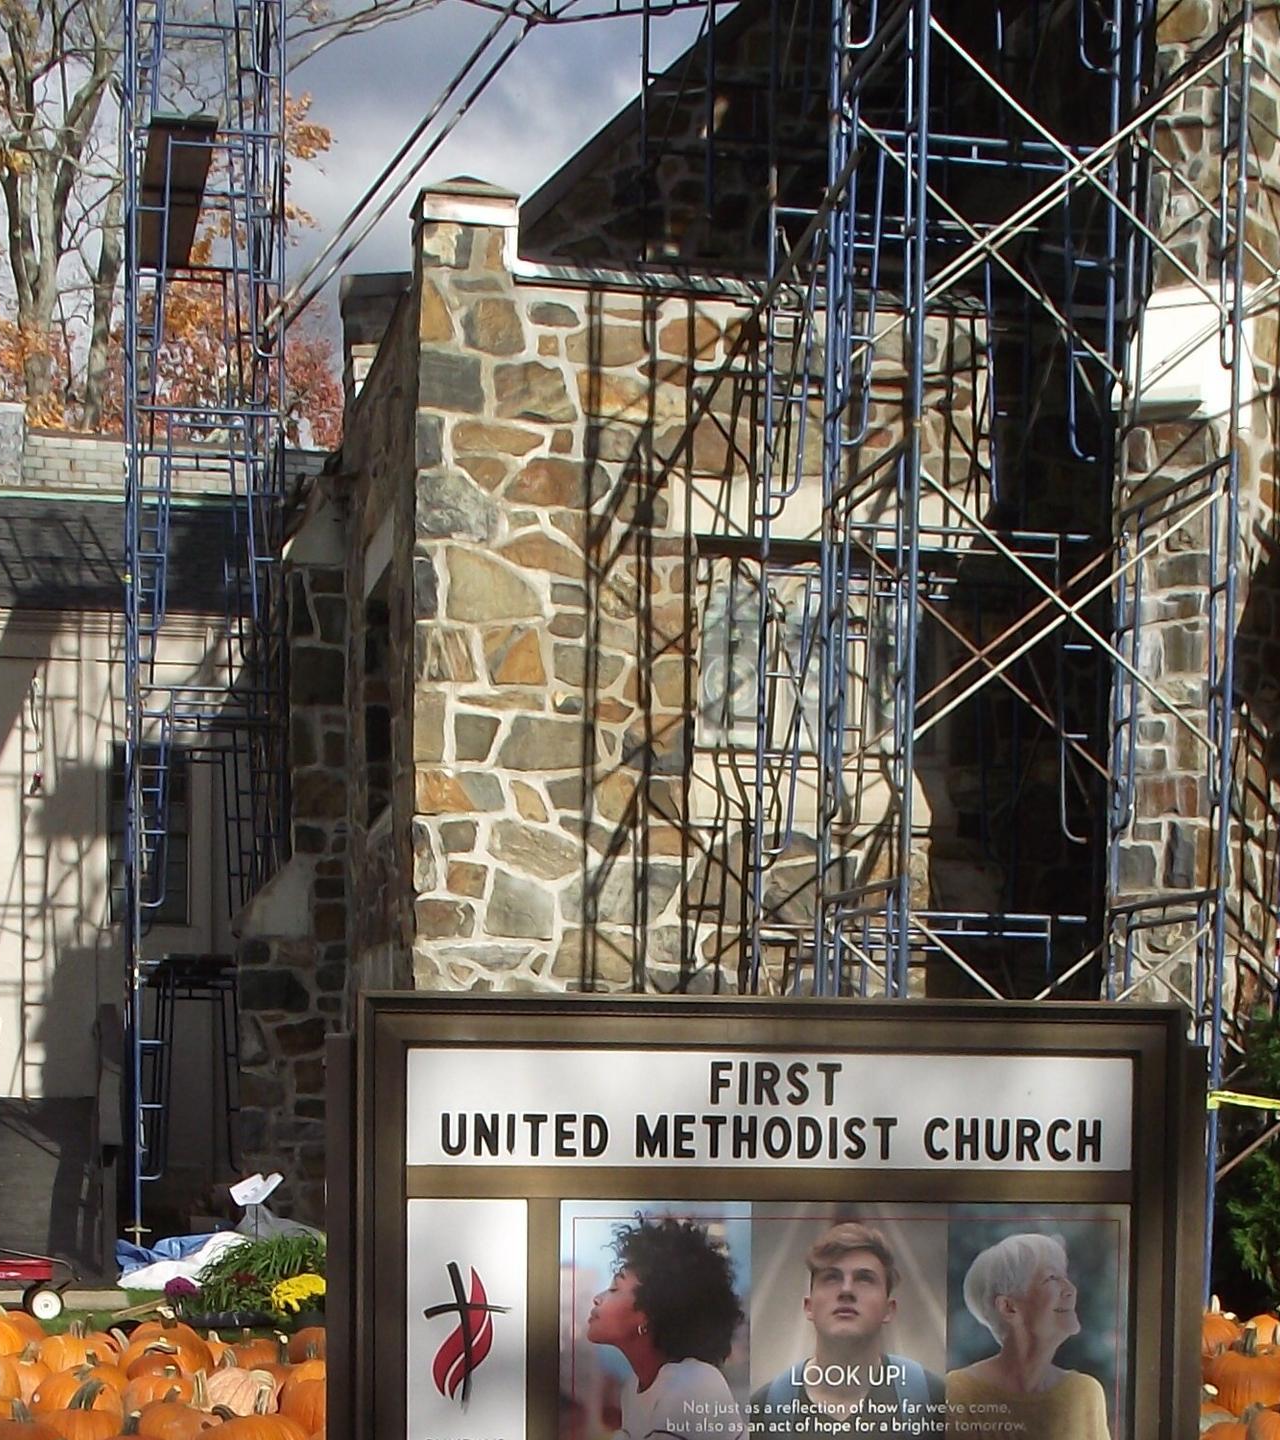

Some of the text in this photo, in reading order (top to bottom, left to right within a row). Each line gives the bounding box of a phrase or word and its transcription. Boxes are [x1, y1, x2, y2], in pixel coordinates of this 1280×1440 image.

[710, 1061, 842, 1106] FIRST
[441, 1113, 1102, 1162] UNITED METHODIST CHURCH
[791, 1365, 906, 1386] LOOK UP!
[683, 1399, 1012, 1418] Not just as a reflection of how far we've come,
[667, 1417, 1027, 1436] but also as an act of hope for a brighter tomorrow.
